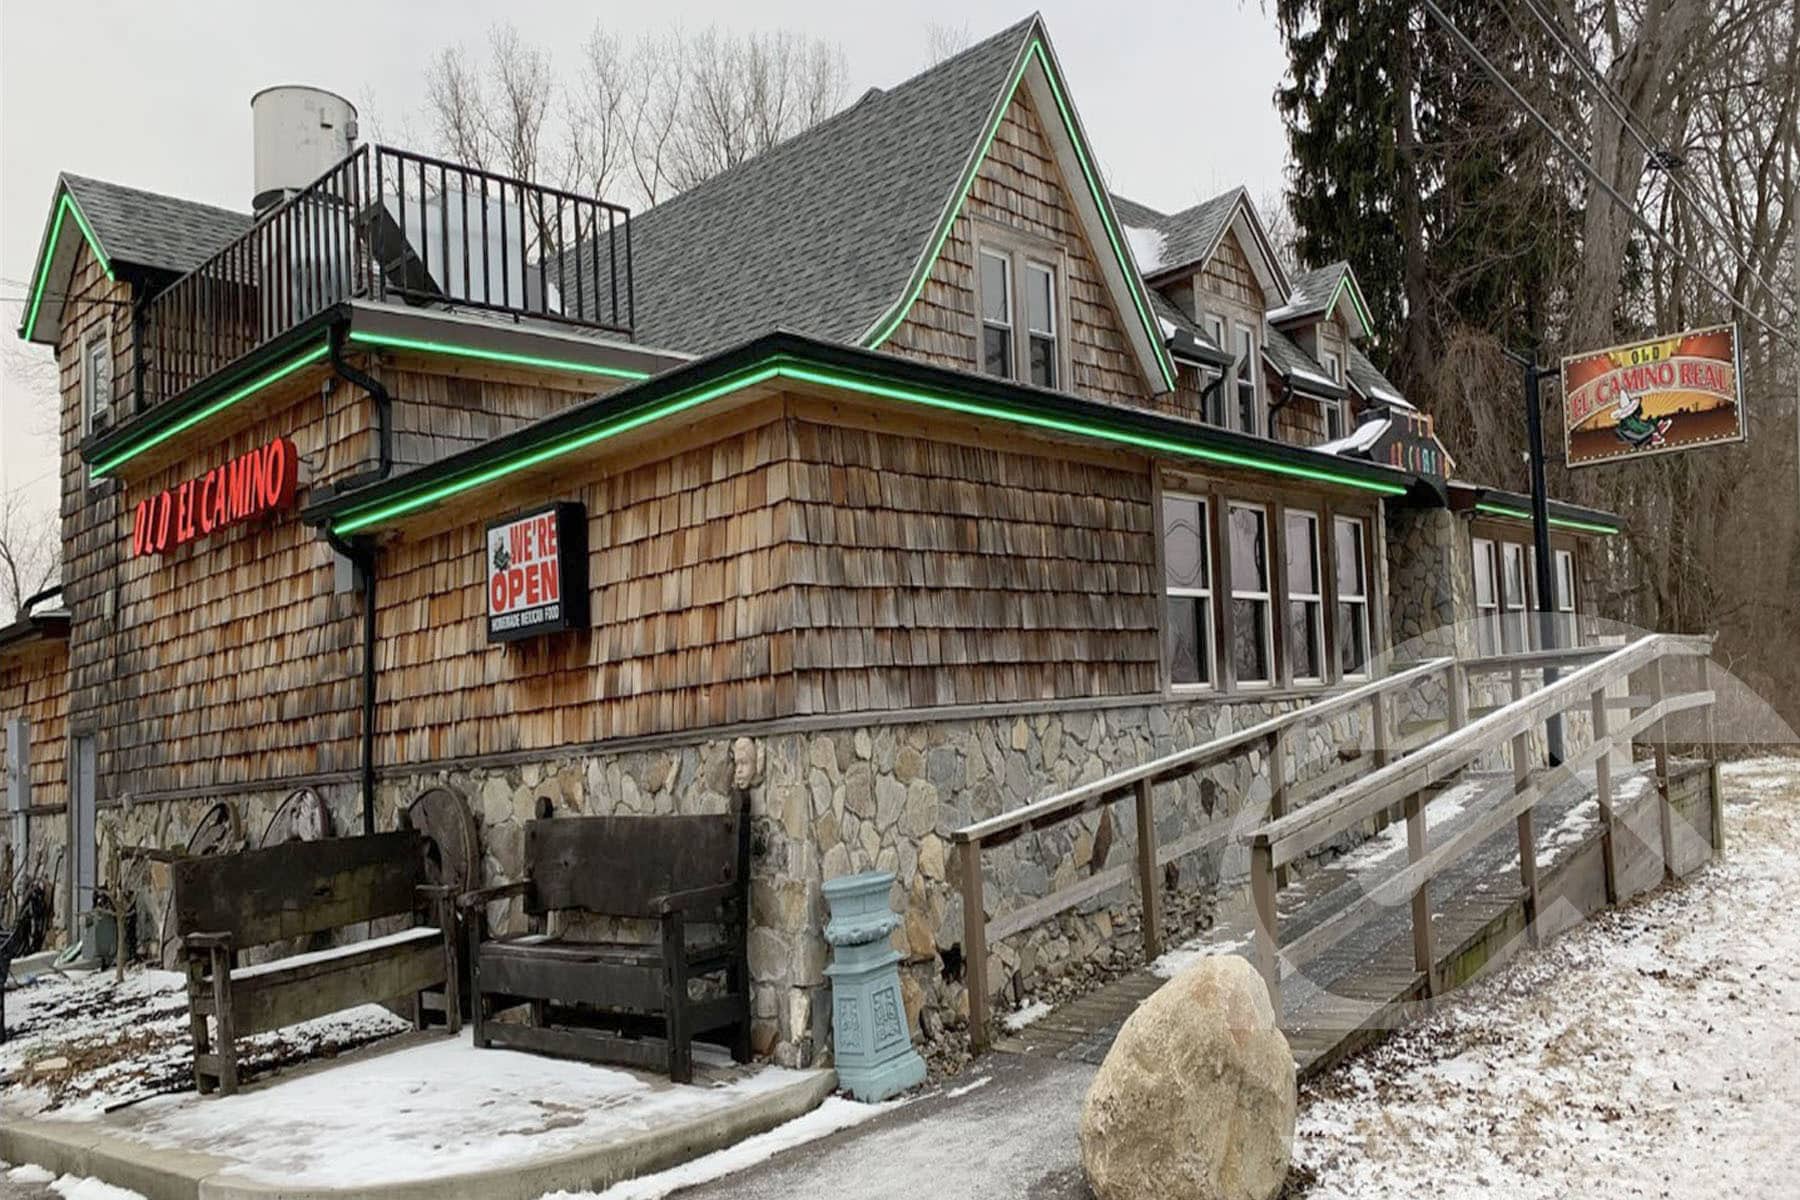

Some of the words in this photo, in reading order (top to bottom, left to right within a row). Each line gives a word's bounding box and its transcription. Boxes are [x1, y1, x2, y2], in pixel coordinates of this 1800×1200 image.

[1631, 346, 1660, 364] OLD
[1571, 391, 1589, 418] EL
[1596, 363, 1674, 402] CAMINO
[1680, 362, 1728, 391] REAL
[133, 490, 171, 556] OLD
[177, 479, 195, 543] EL
[201, 437, 285, 533] CAMINO
[510, 514, 557, 564] WE'RE
[491, 559, 558, 612] OPEN
[544, 605, 560, 620] FOOD
